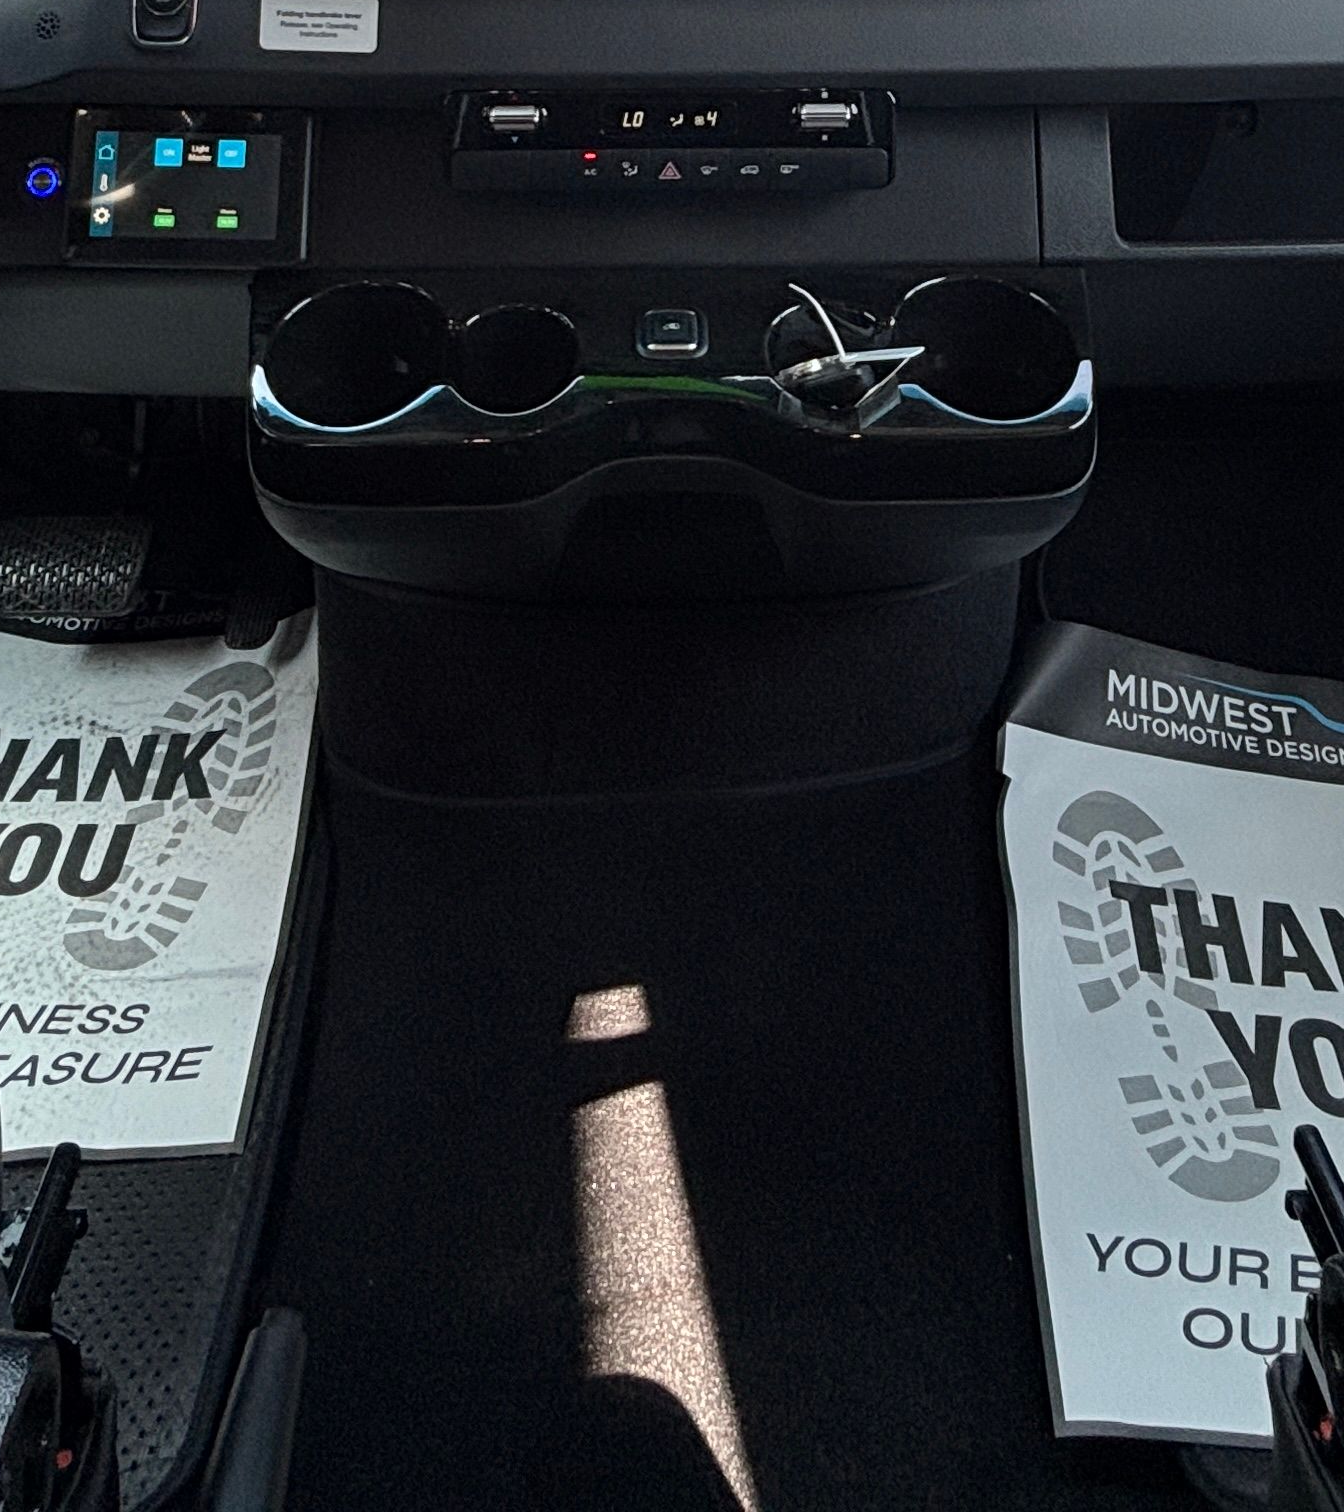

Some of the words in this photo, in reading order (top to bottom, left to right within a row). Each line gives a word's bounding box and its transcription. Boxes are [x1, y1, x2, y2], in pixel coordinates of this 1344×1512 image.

[706, 110, 719, 128] 4
[1107, 668, 1298, 737] MIDWEST
[1106, 707, 1259, 754] AUTOMOTIVE
[1085, 1232, 1270, 1290] YOUR
[1182, 1307, 1305, 1356] OU
